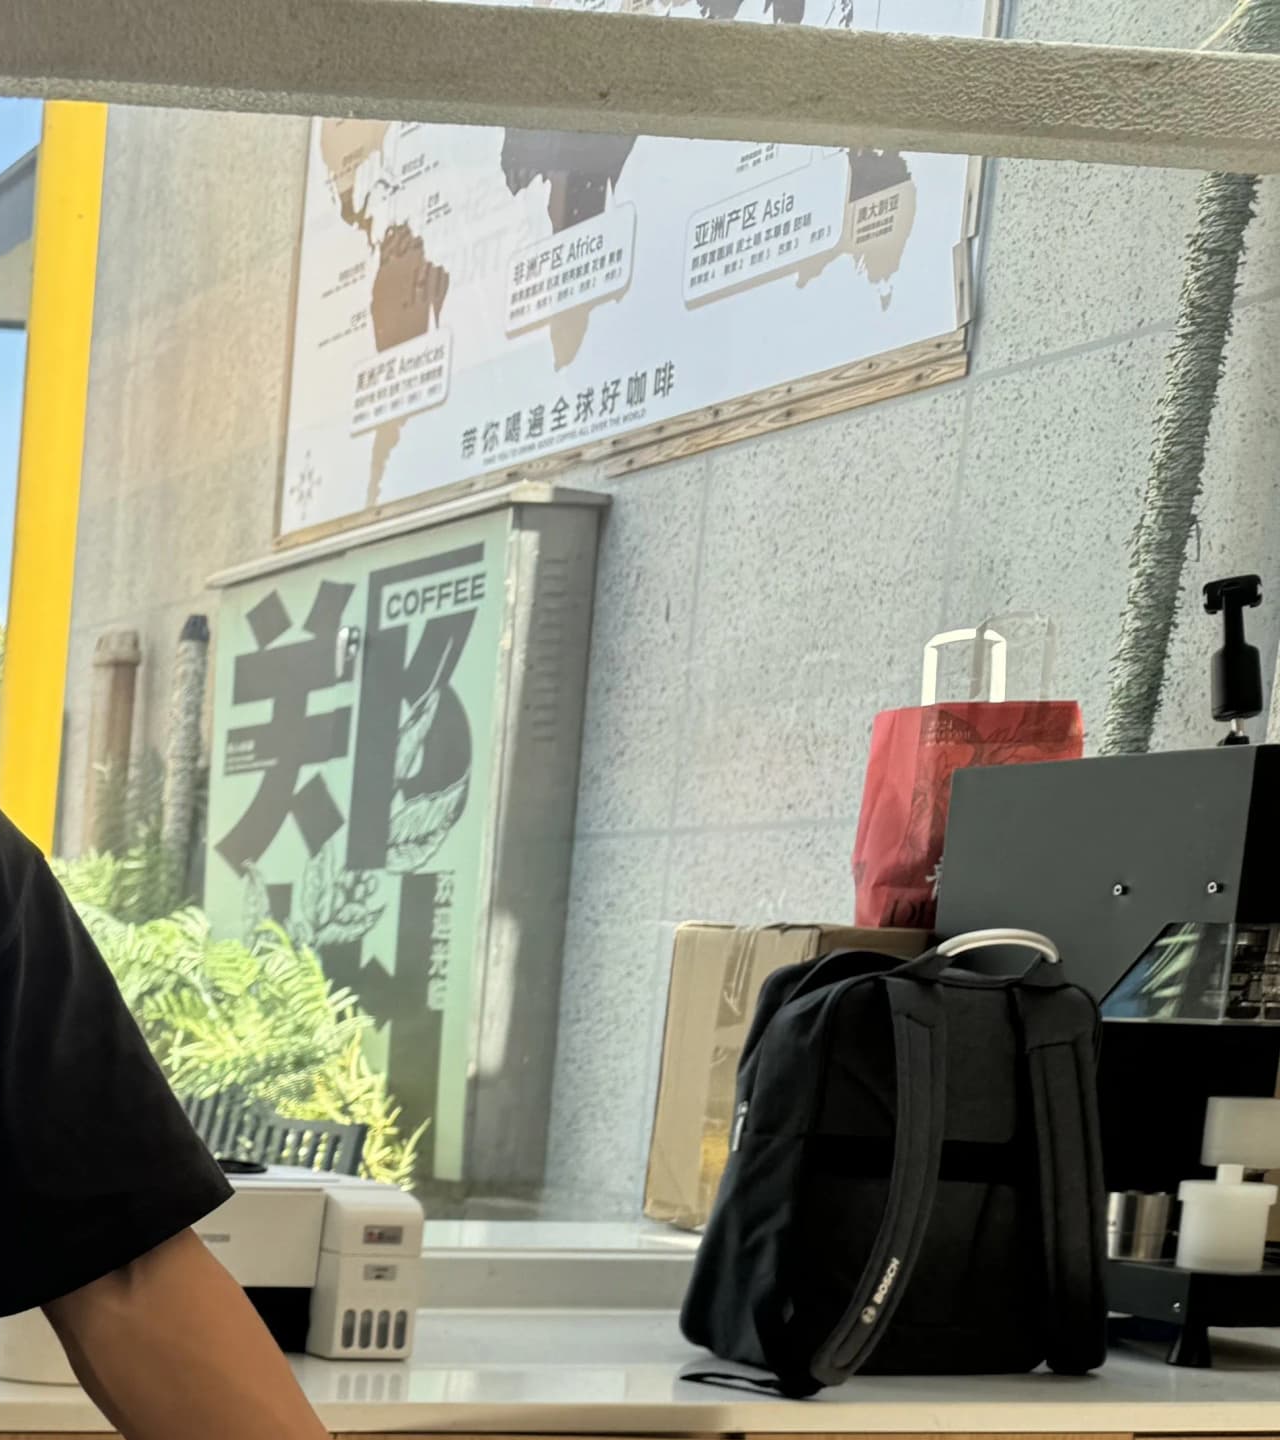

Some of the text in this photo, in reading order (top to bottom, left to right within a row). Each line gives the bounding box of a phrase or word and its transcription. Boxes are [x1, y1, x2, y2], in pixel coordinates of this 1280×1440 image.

[693, 201, 759, 249] 亚洲产区
[762, 192, 794, 223] Asia
[566, 234, 604, 263] Africa
[462, 360, 675, 459] 带你喝遍全球好咖啡
[386, 573, 486, 620] COFFEE
[873, 1257, 900, 1304] BOSCH
